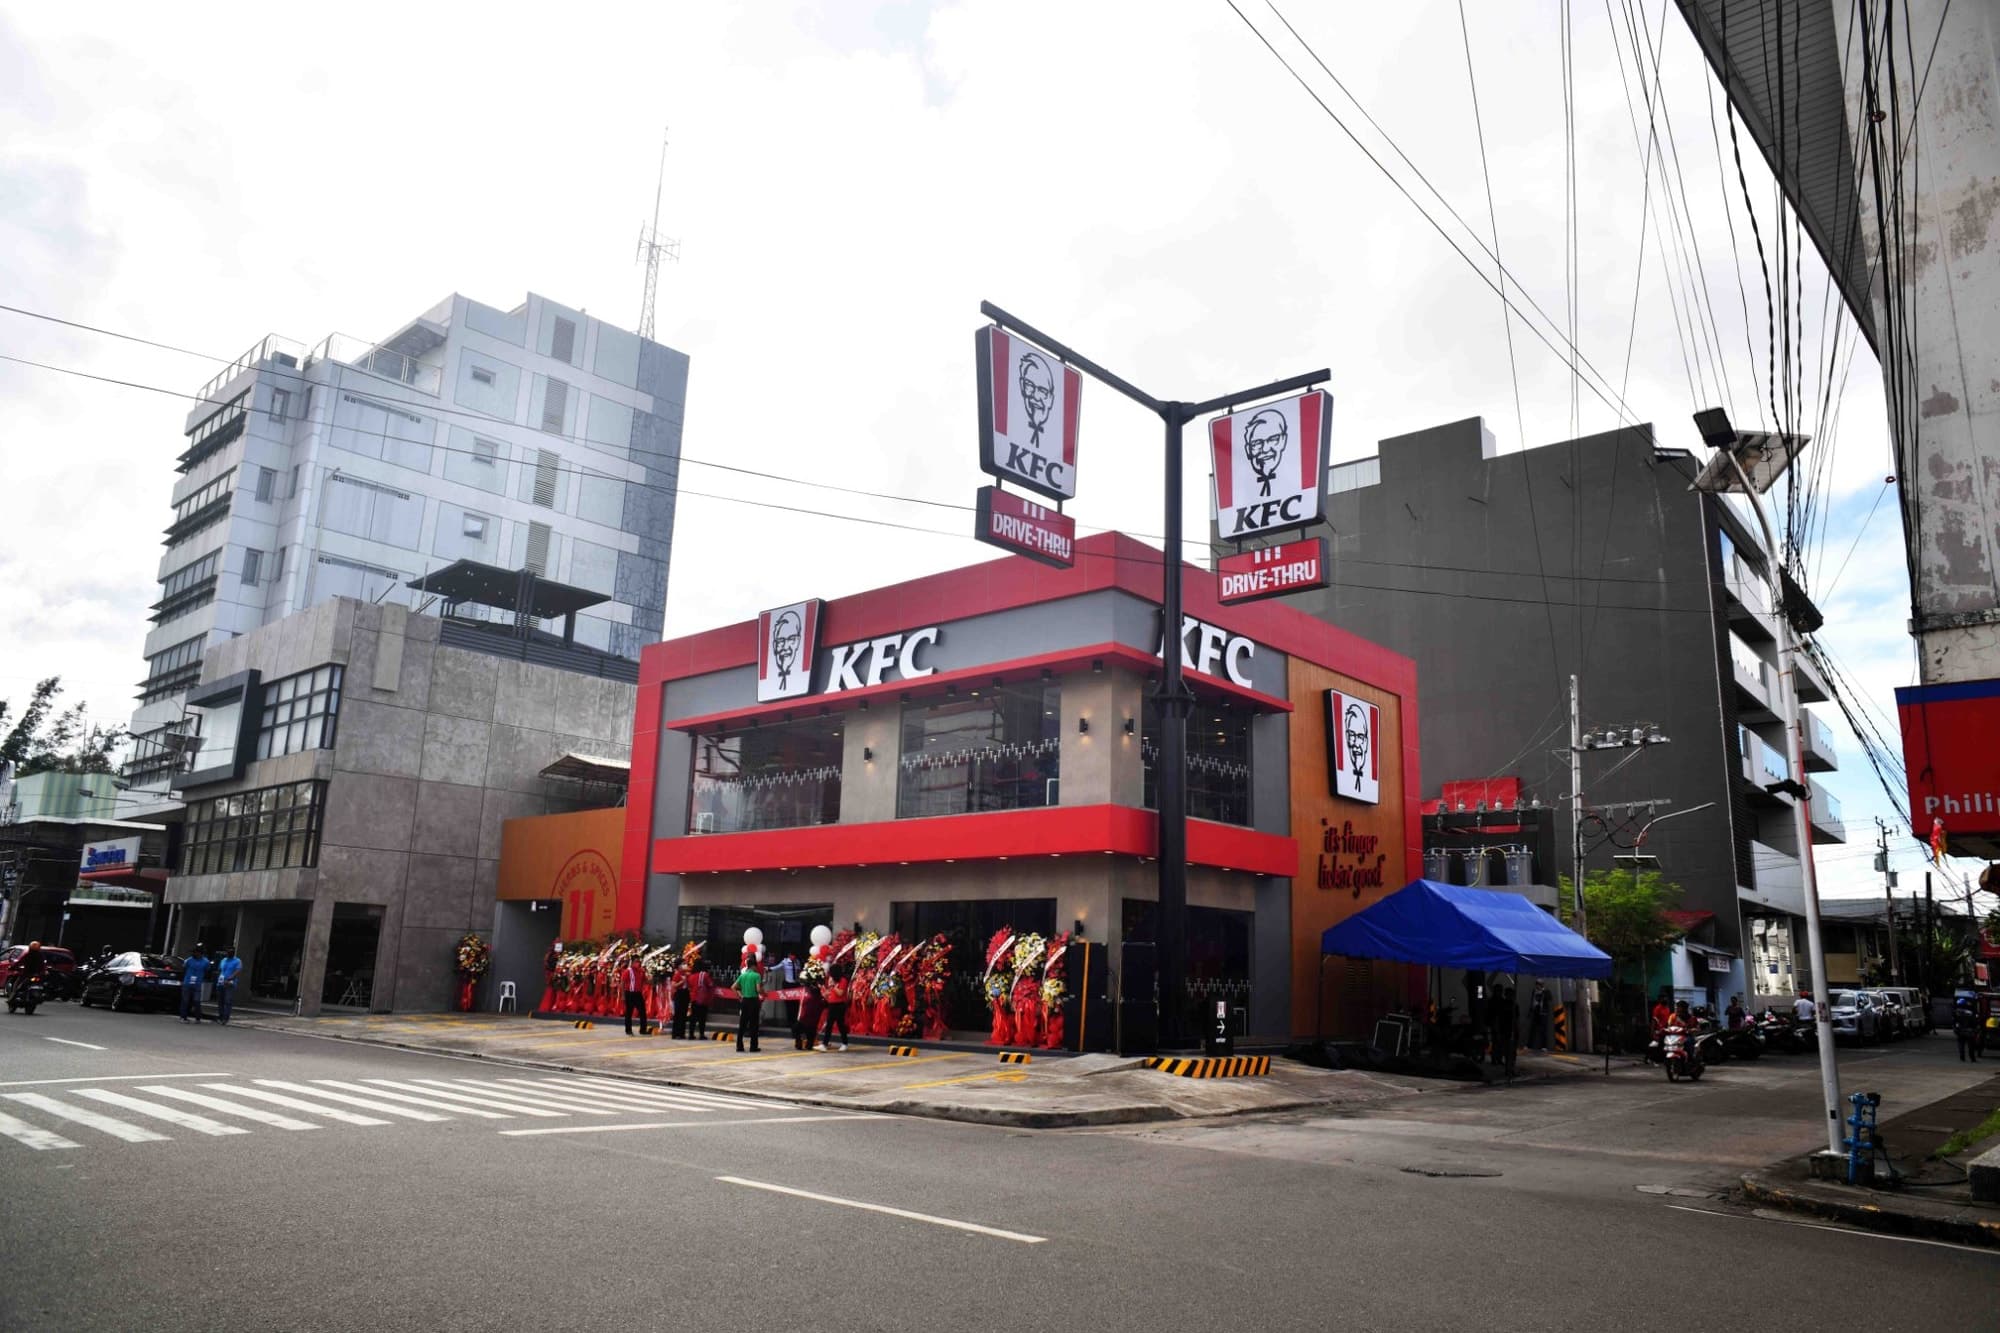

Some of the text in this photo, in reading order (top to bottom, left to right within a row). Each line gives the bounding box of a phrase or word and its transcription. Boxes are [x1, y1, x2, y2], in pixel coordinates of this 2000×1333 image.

[1006, 442, 1064, 490] KFC
[992, 512, 1071, 559] DRIVE-THRU
[1232, 494, 1303, 533] KFC
[1222, 559, 1317, 597] DRIVE-THRU
[824, 627, 938, 694] KFC
[1156, 615, 1254, 689] KFC
[1924, 792, 2000, 815] Phili
[569, 889, 595, 940] 11
